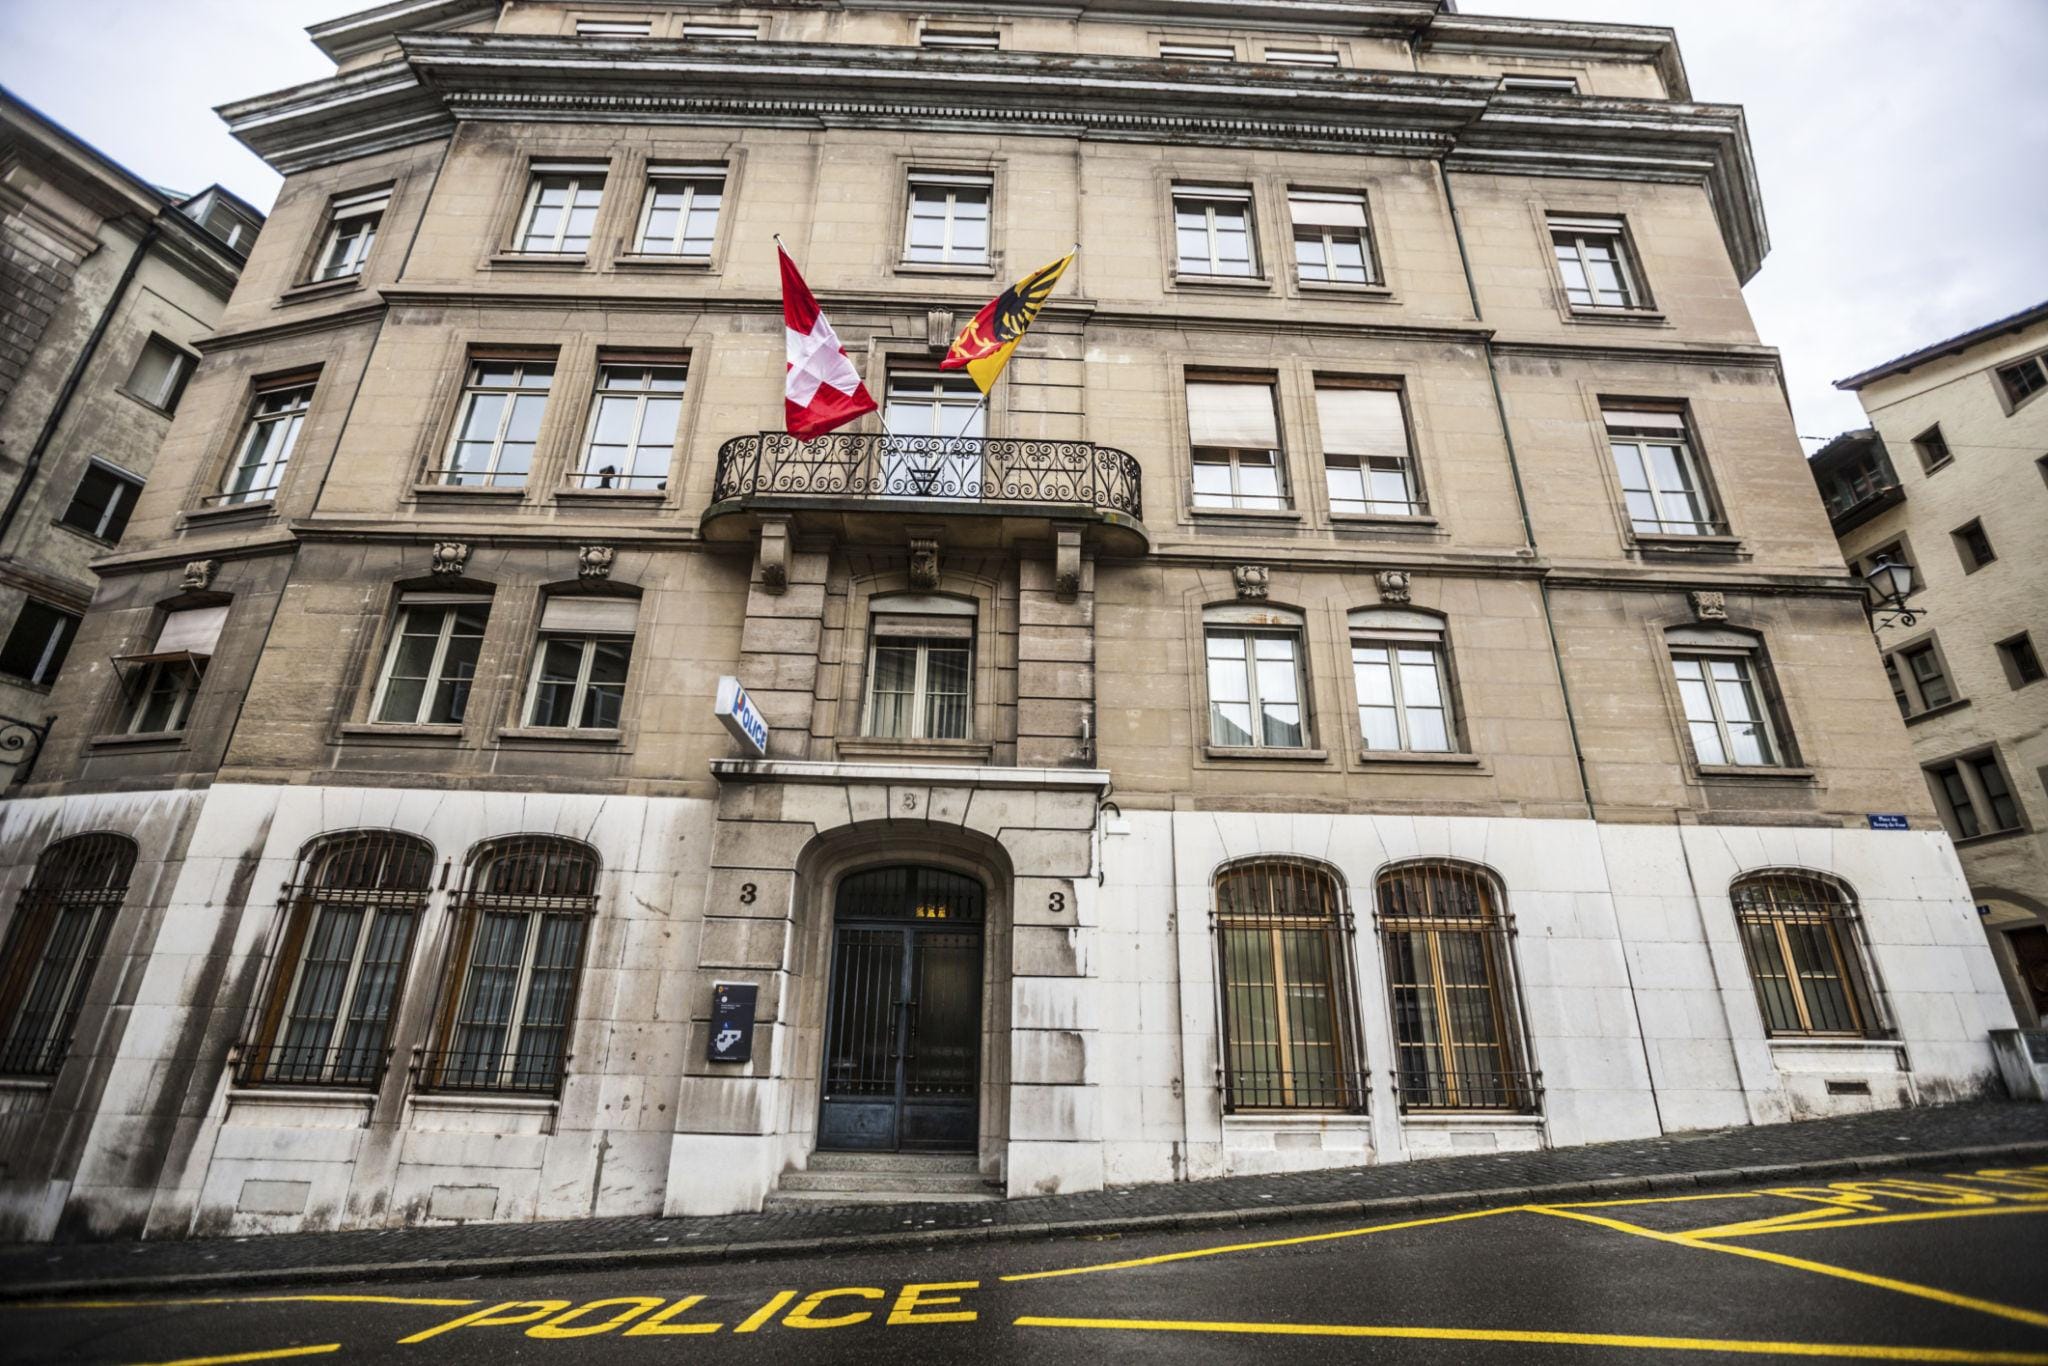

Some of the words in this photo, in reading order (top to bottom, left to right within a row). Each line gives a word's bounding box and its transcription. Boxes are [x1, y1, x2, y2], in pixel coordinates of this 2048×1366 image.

[733, 687, 767, 750] POLICE
[903, 793, 915, 809] 3
[741, 883, 757, 905] 3
[1049, 892, 1064, 912] 3
[398, 1281, 979, 1344] POLICE
